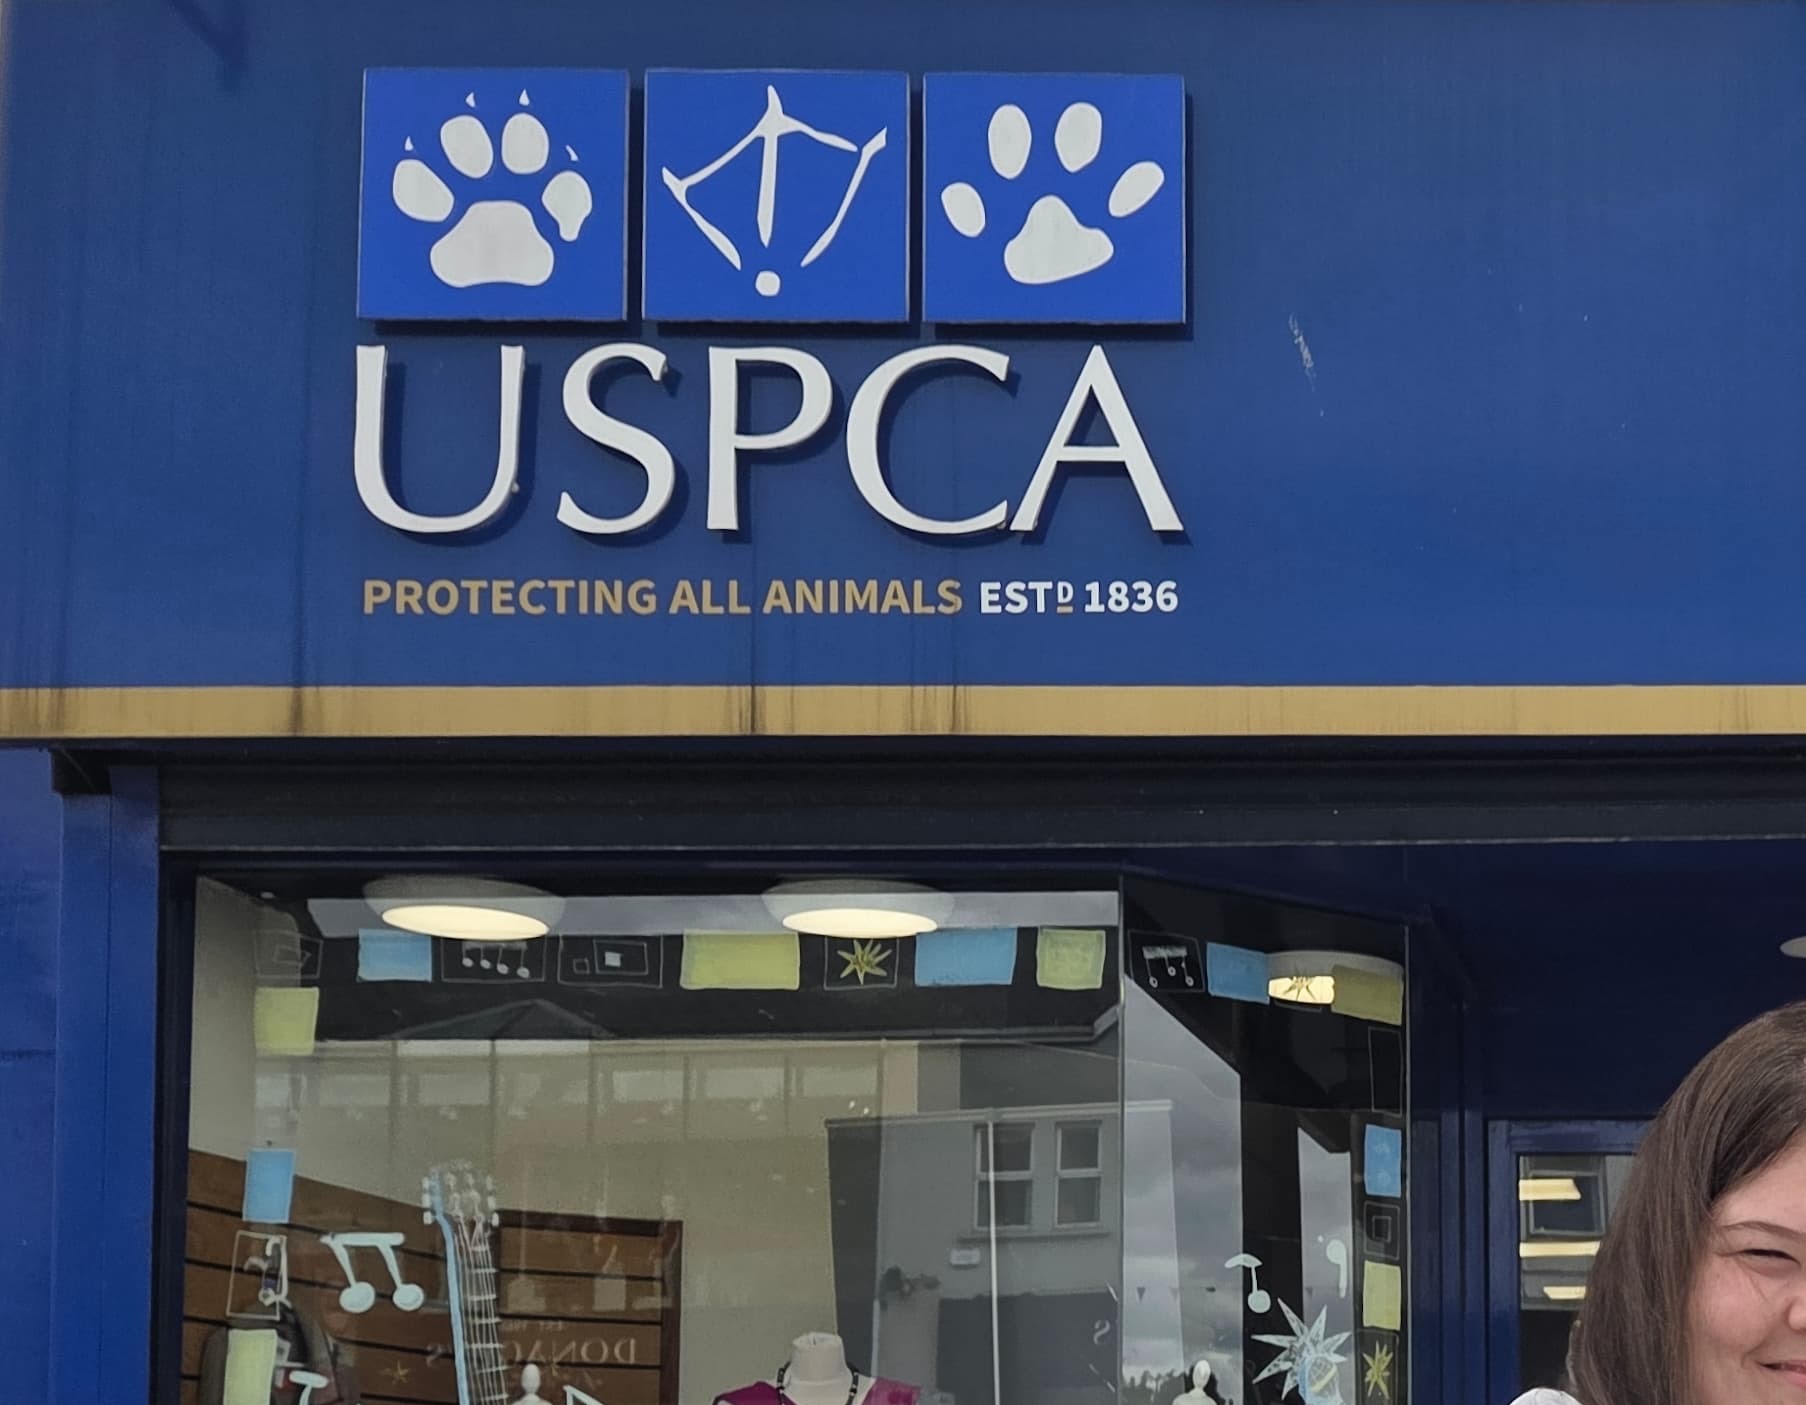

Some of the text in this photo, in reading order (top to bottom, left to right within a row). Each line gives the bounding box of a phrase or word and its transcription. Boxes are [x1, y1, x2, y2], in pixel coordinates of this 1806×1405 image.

[353, 342, 1184, 536] USPCA
[362, 578, 658, 617] PROTECTING
[668, 579, 752, 616] ALL
[762, 579, 963, 616] ANIMALS
[1083, 580, 1180, 615] 1836
